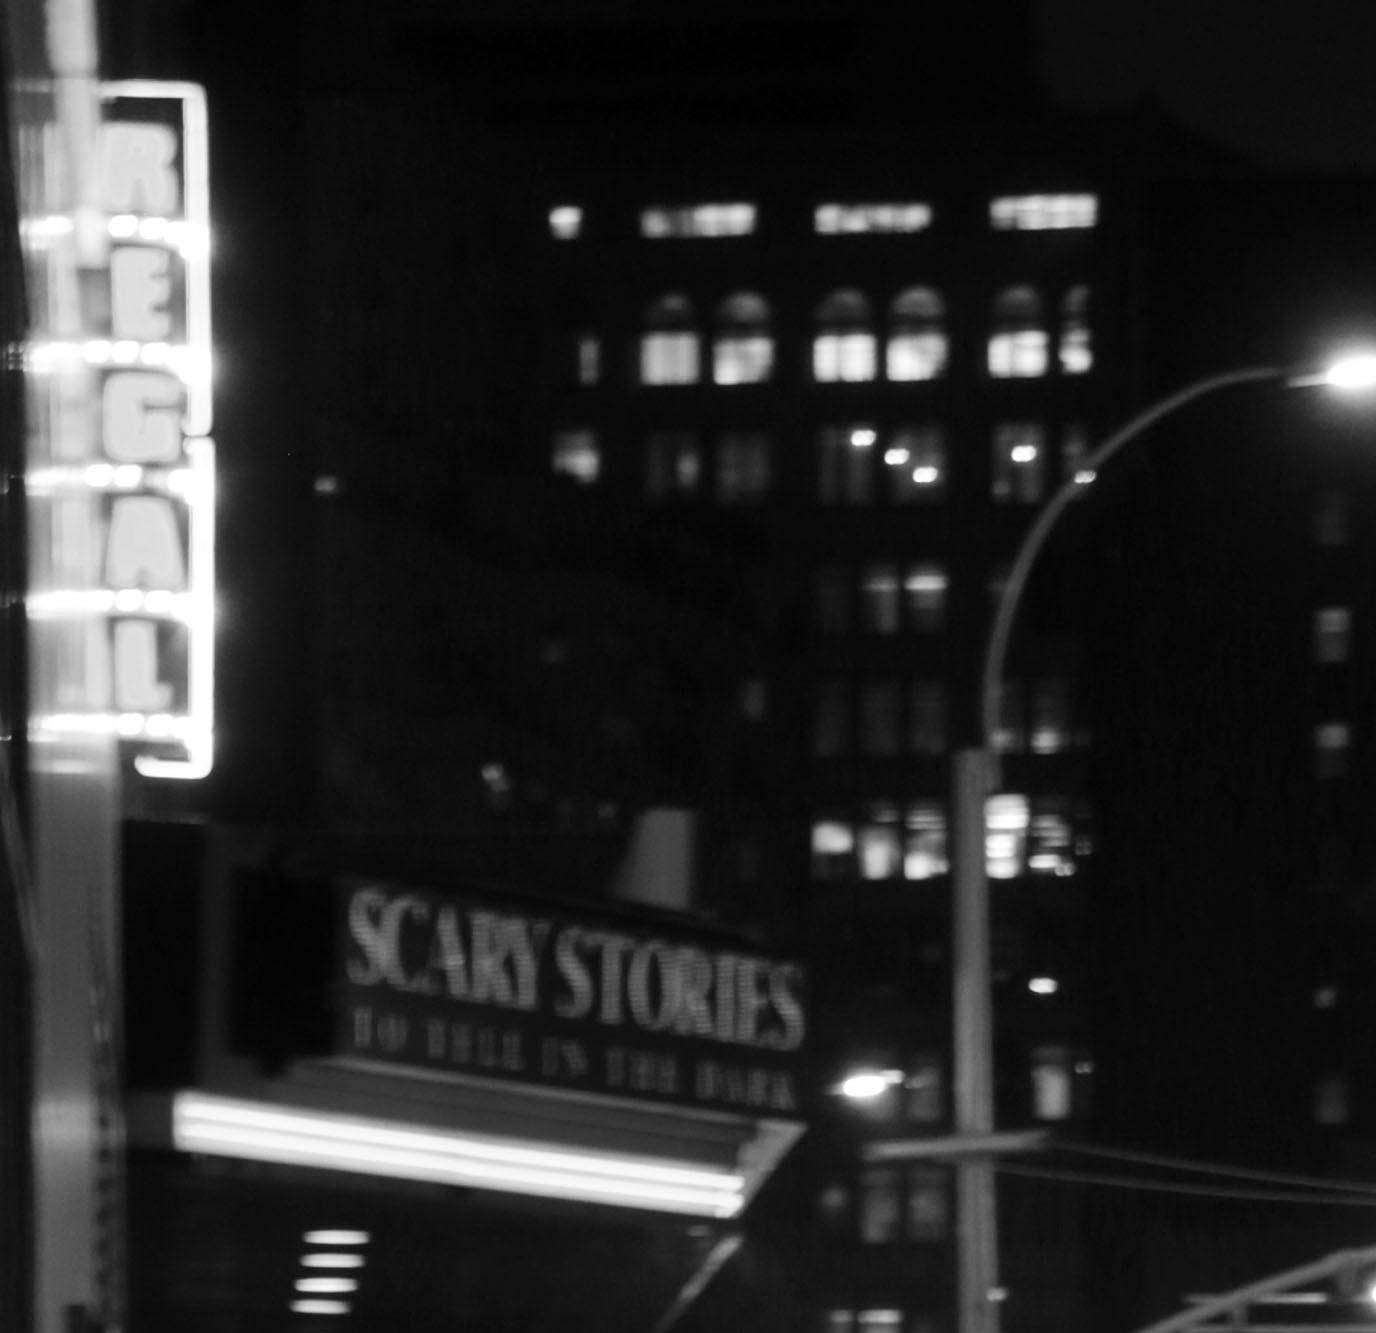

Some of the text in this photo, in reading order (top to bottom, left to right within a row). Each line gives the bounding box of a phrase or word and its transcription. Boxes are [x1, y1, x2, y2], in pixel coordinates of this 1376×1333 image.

[100, 122, 186, 712] REGAL
[345, 887, 806, 1052] SCARY STORIES
